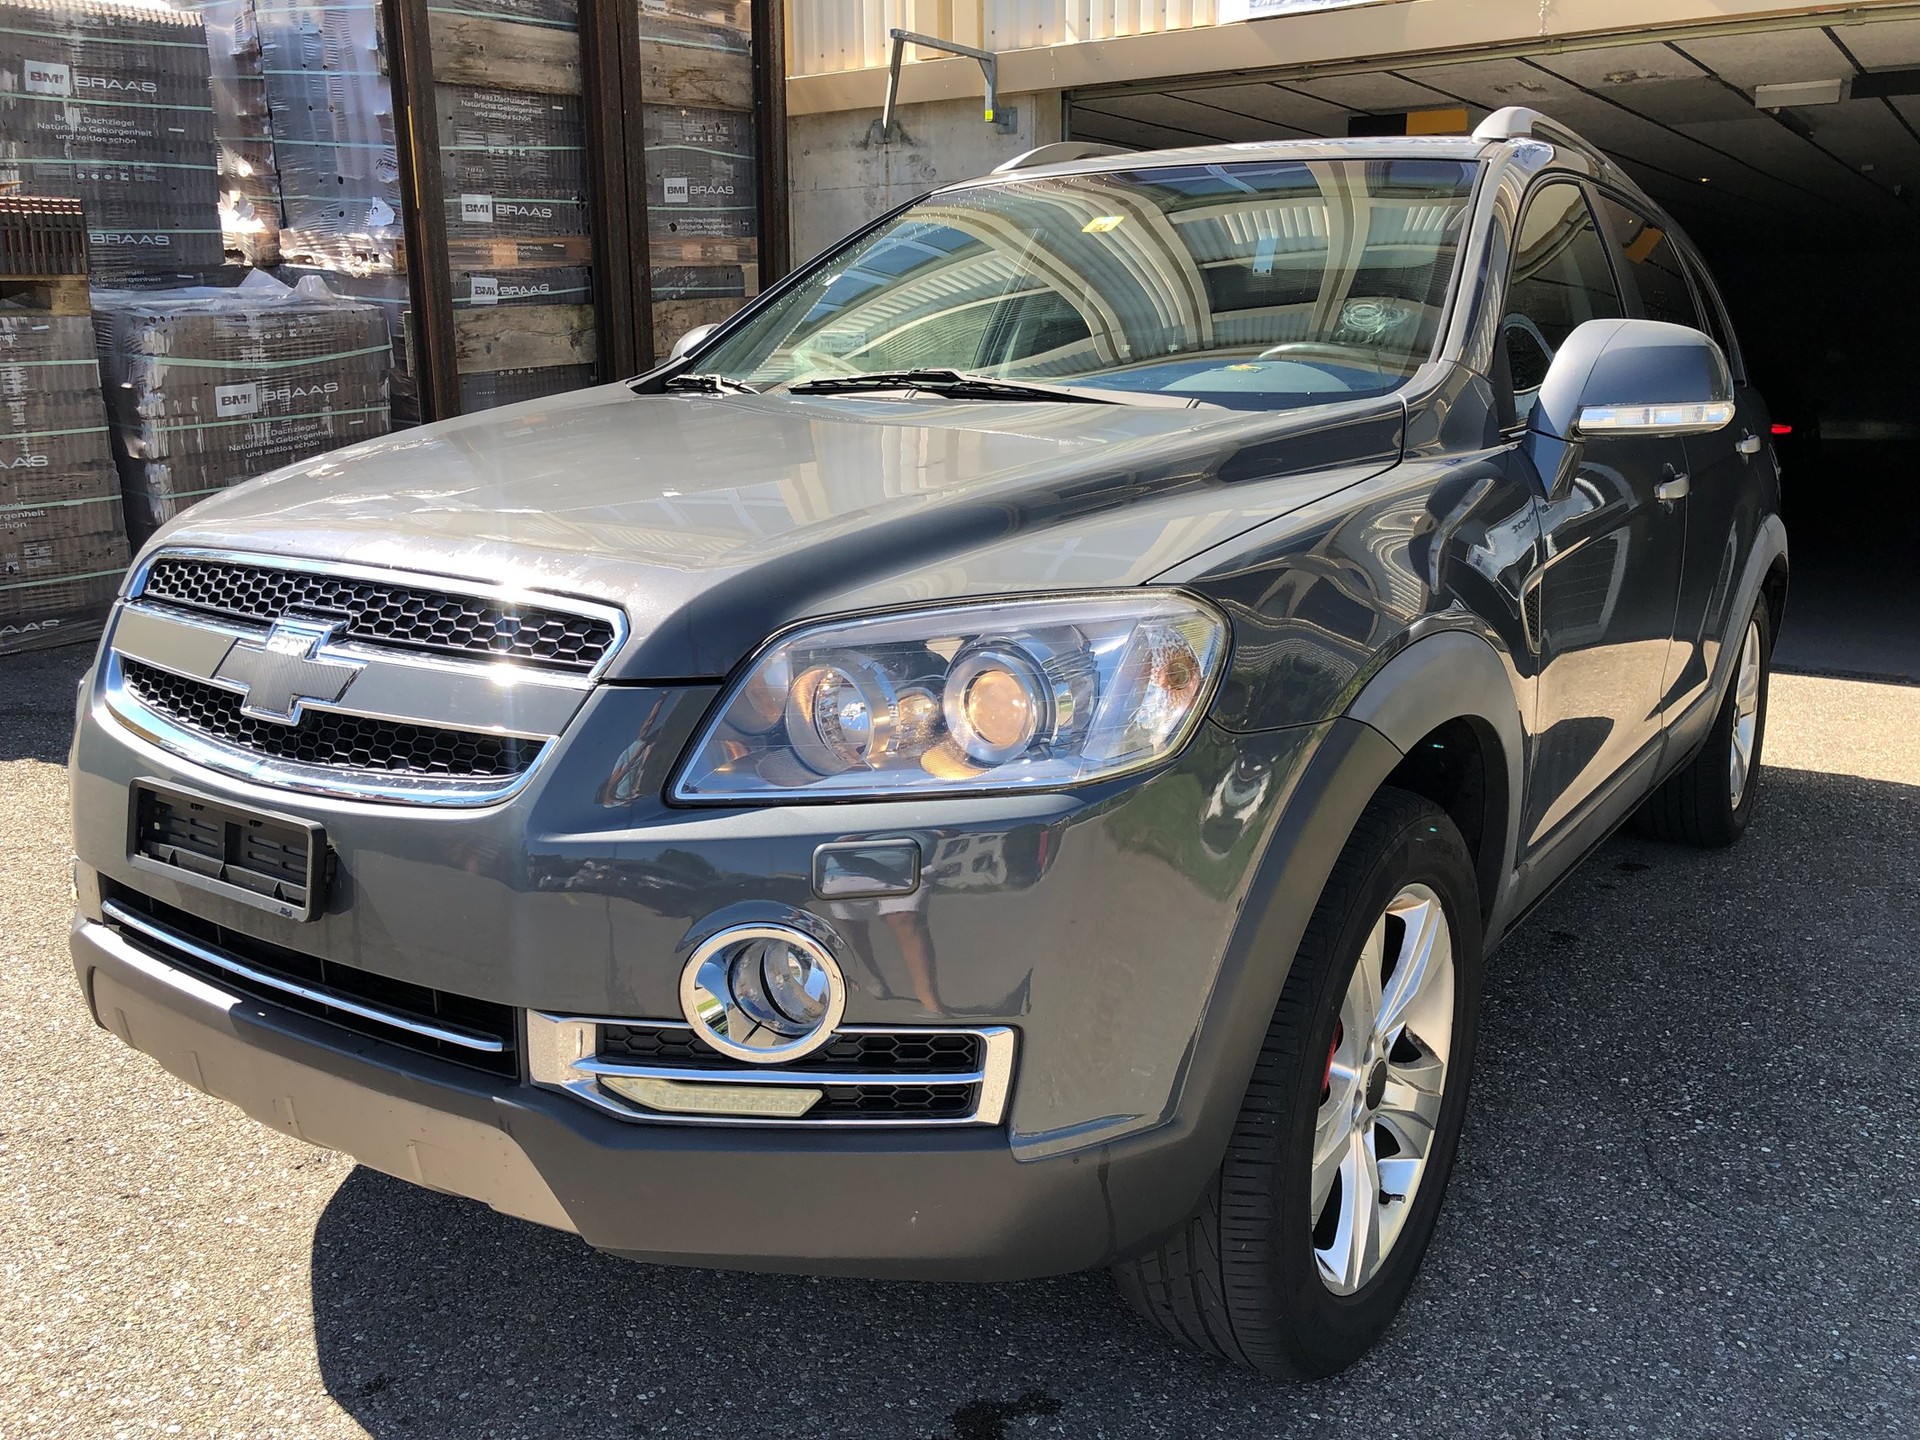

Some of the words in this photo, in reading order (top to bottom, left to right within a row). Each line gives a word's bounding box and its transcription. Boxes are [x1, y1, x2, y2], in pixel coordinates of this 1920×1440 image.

[30, 71, 63, 84] BMI
[75, 76, 157, 93] BRAAS
[84, 116, 135, 128] Dachziegel
[37, 122, 87, 133] Natürlihe
[88, 126, 153, 137] Geborgenheit
[56, 133, 74, 141] und
[76, 134, 107, 143] zeitlos
[108, 136, 137, 144] schön
[667, 186, 686, 195] BMI
[690, 186, 735, 195] BRAAS
[465, 203, 489, 213] BMI
[496, 204, 552, 218] BRAAS
[90, 233, 170, 246] BRAAS
[474, 286, 496, 295] BMI
[500, 283, 549, 296] BRAAS
[221, 393, 252, 407] BMI
[262, 382, 339, 402] BRAAS
[271, 423, 318, 436] Dachziegel
[246, 449, 263, 458] und
[264, 444, 293, 455] zeitlos
[295, 440, 320, 450] schön
